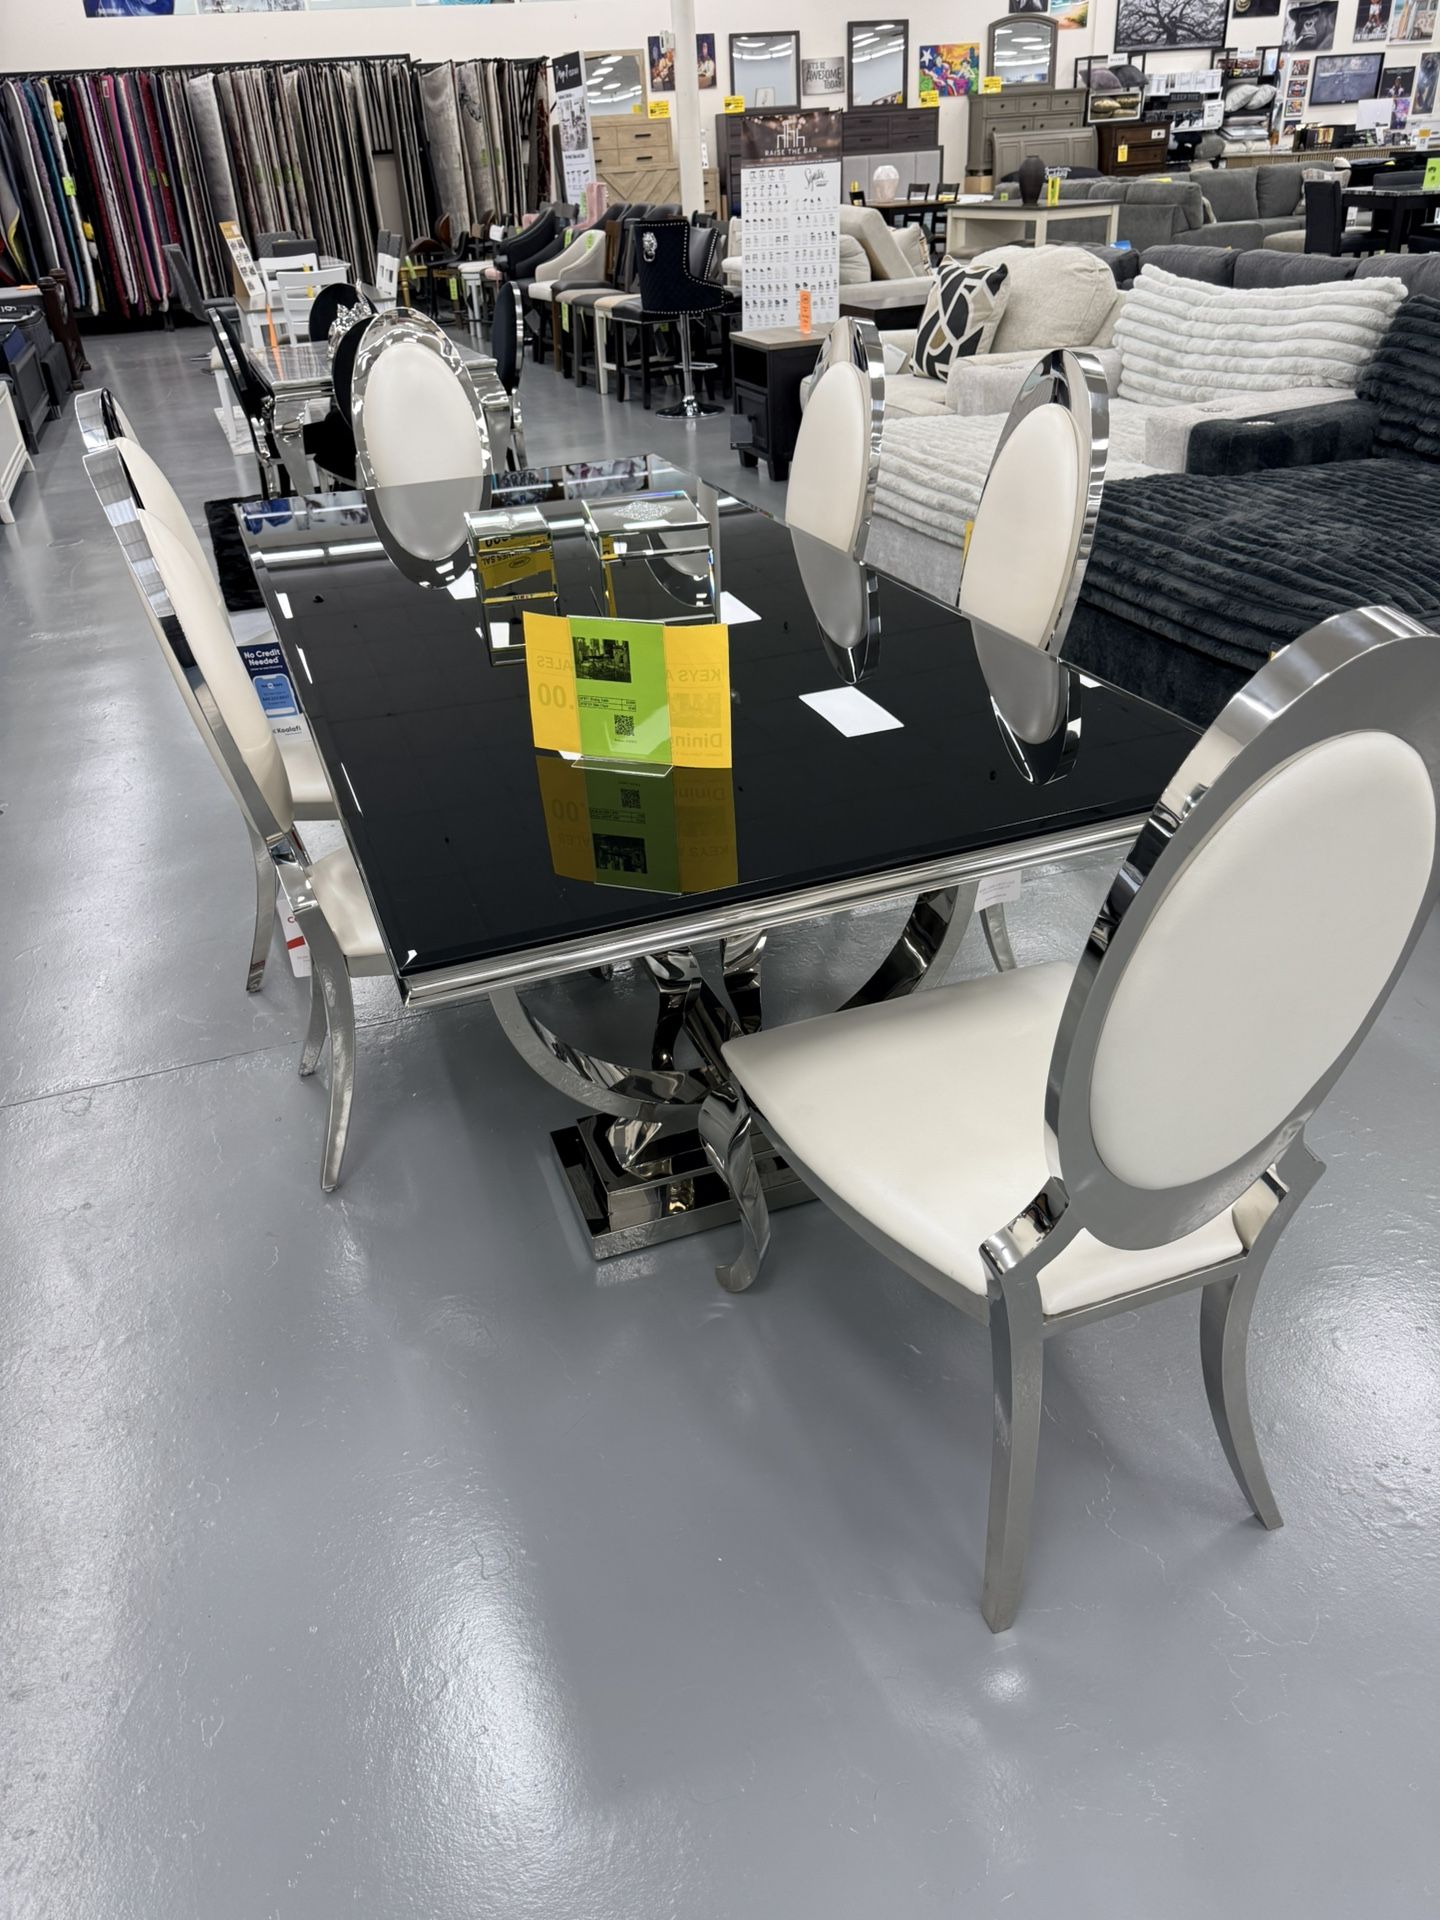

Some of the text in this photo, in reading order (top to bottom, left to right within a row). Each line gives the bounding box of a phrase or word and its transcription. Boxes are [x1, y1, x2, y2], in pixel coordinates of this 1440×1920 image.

[806, 68, 842, 81] AWESOME
[243, 649, 281, 659] No Credit
[248, 657, 279, 666] Needed
